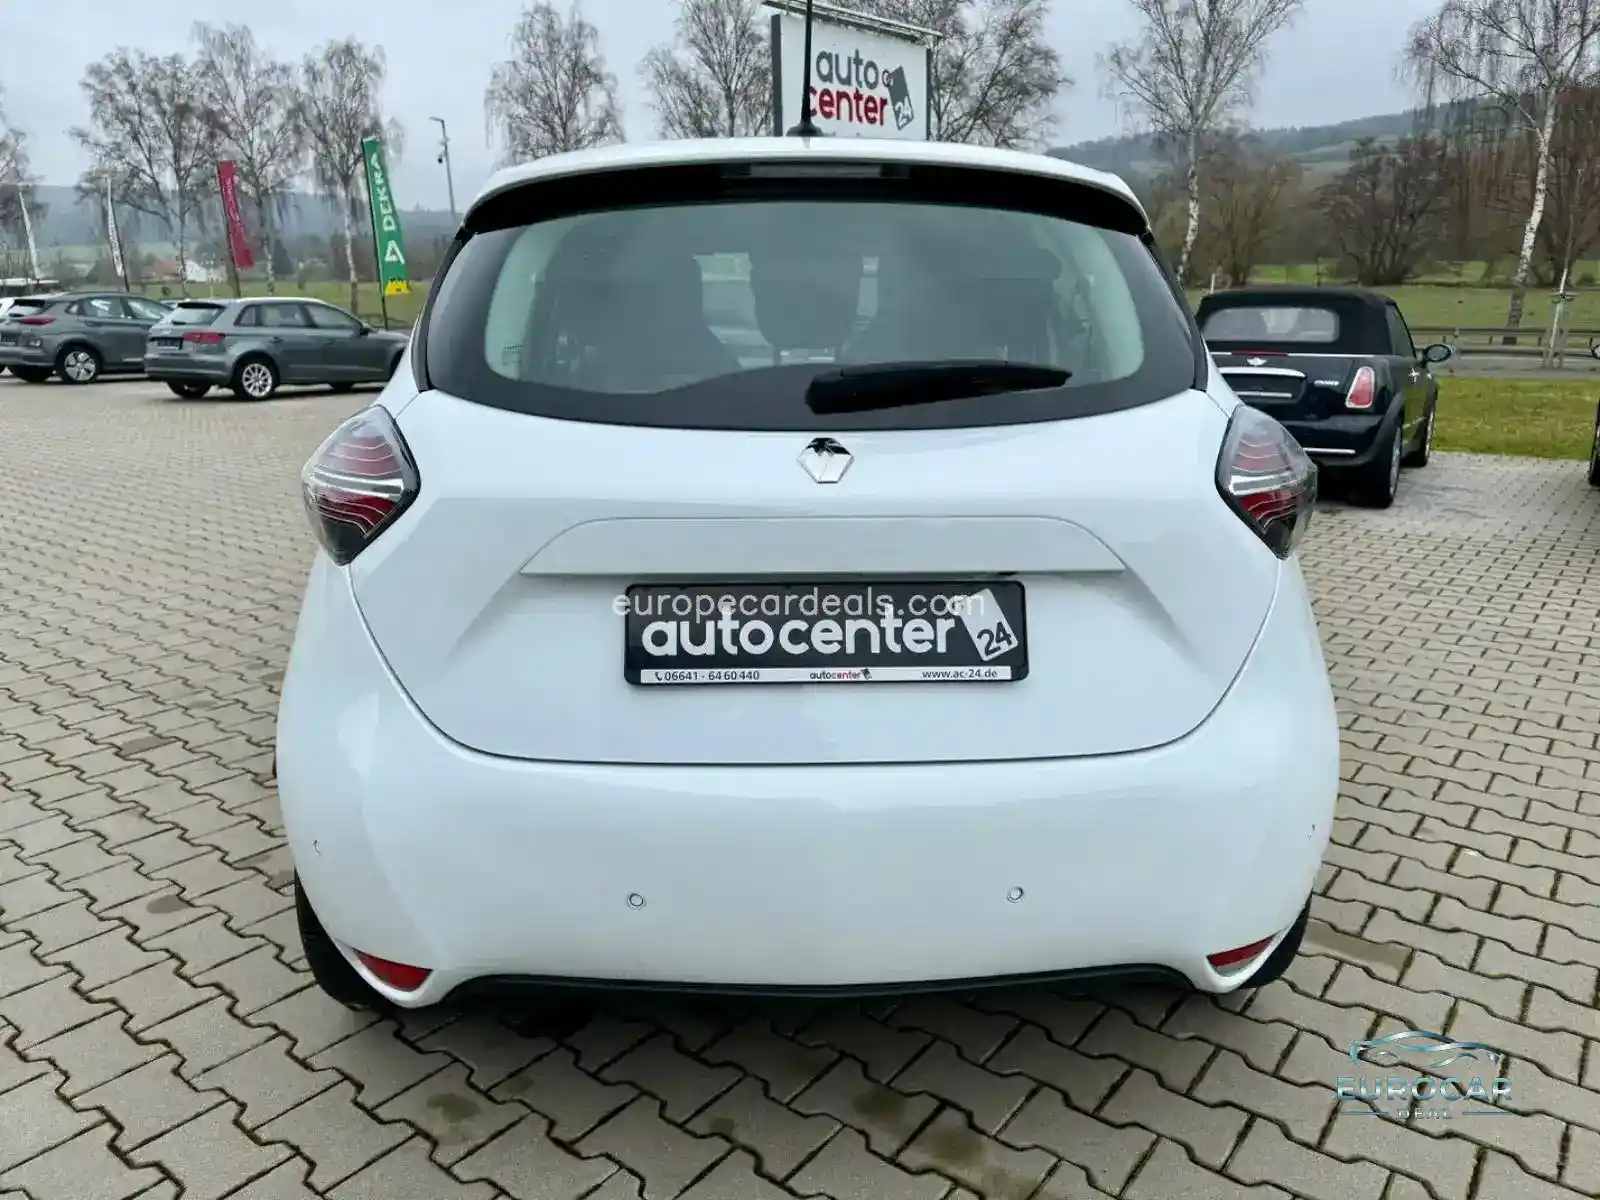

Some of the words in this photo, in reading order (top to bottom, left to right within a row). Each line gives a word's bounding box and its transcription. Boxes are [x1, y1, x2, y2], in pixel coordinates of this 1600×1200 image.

[816, 48, 880, 90] auto
[370, 152, 397, 232] DEKRA
[641, 603, 955, 656] autocenter
[976, 621, 1013, 656] 24
[664, 670, 698, 681] 06641
[809, 670, 861, 680] autocenter
[922, 668, 998, 679] www.ac-24.de
